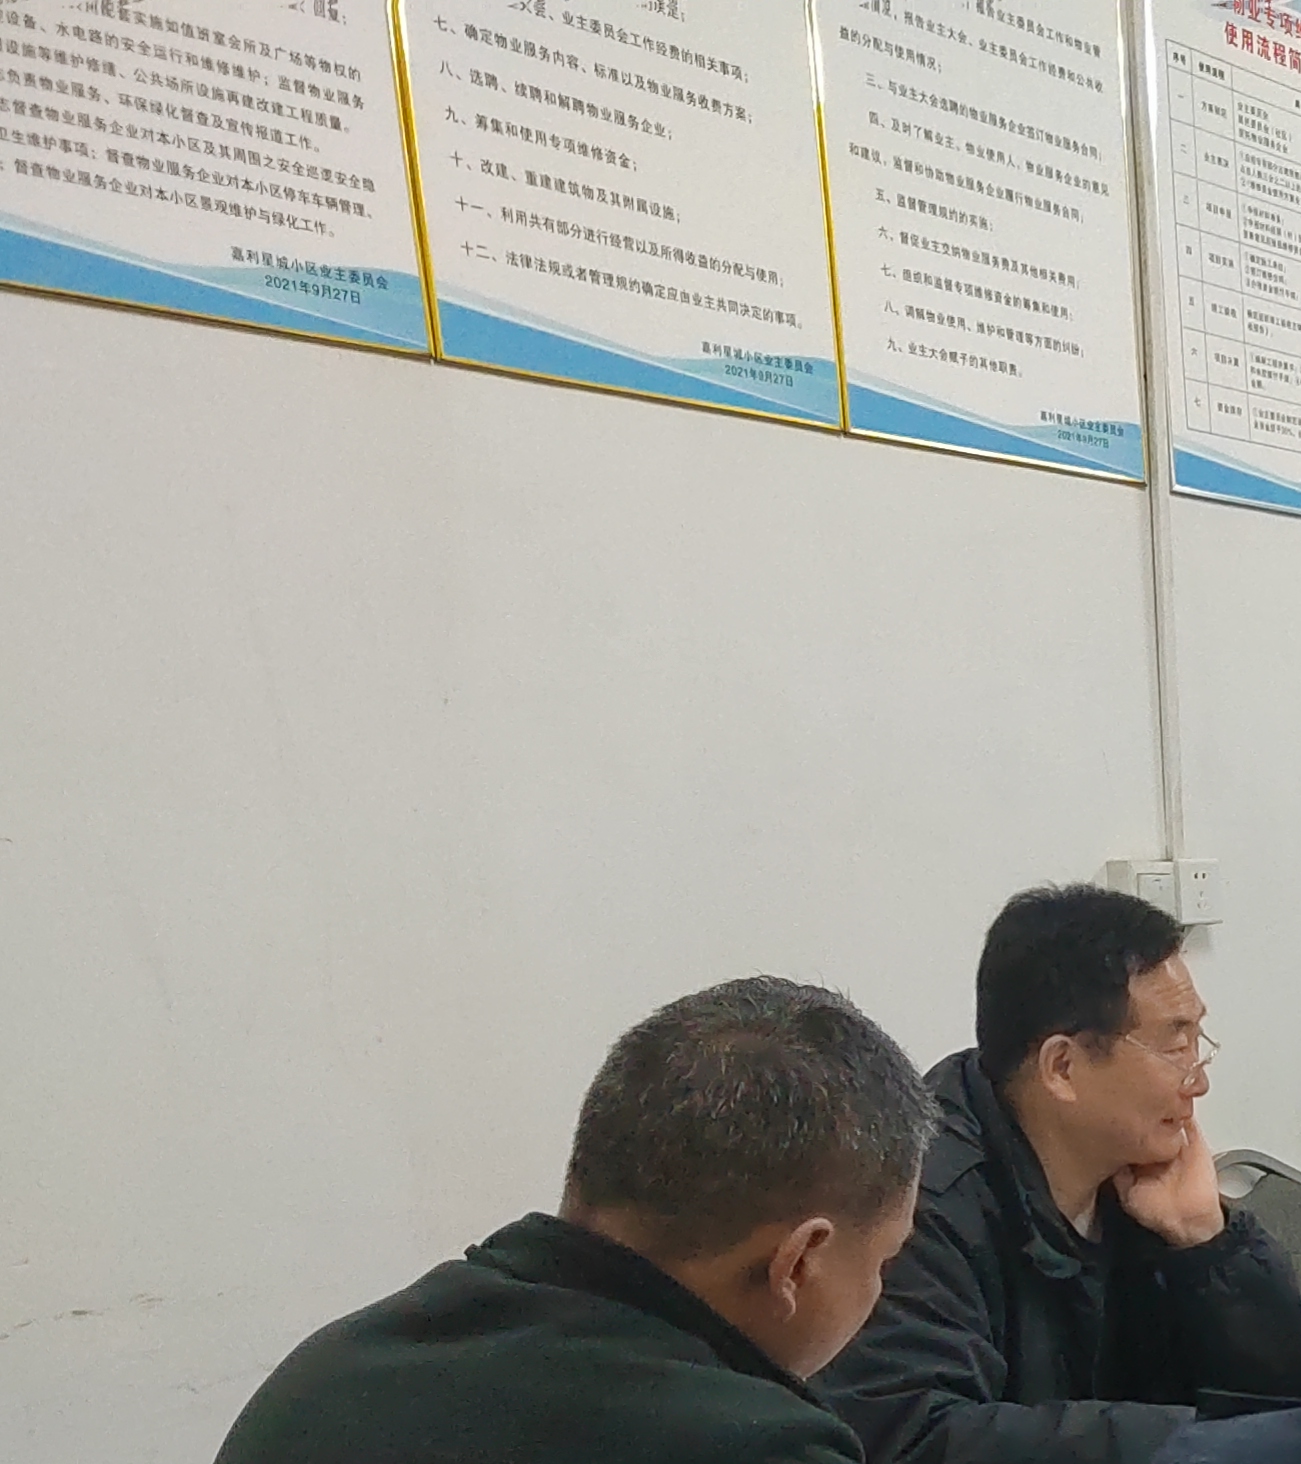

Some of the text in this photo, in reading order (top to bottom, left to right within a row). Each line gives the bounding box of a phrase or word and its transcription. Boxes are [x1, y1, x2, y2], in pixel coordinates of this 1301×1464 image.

[0, 69, 320, 153] 负责物业服务、环保绿化督查及宣传报道工作。
[231, 246, 389, 291] 嘉利星城小区业主委员会
[264, 275, 361, 305] 2021年9月27日
[724, 364, 795, 388] 2021年9月27日
